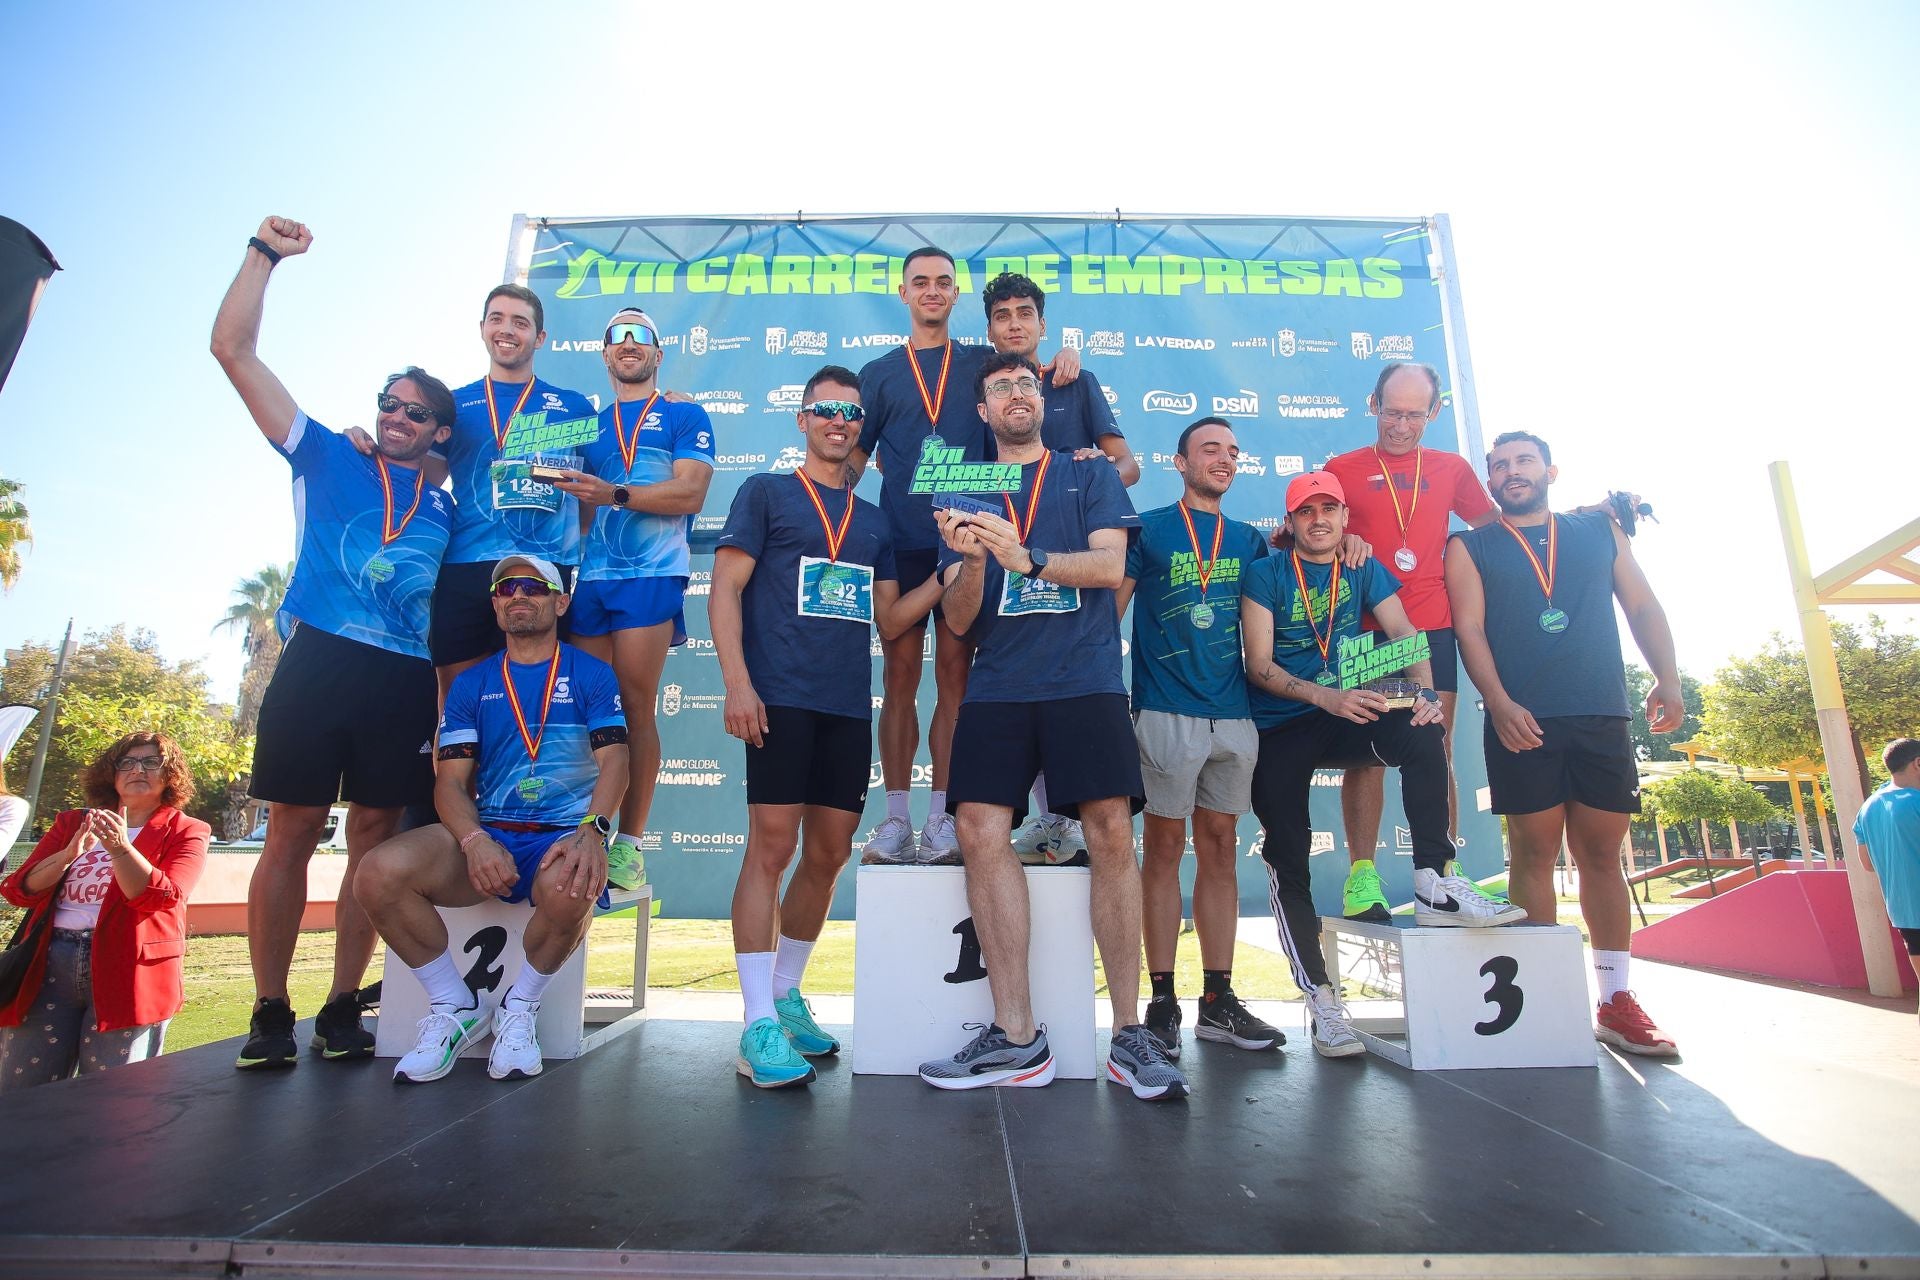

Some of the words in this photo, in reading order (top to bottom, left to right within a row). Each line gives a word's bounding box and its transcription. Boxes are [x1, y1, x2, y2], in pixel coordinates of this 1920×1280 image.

[598, 255, 678, 294] VII
[1071, 254, 1404, 299] EMPRESAS
[551, 340, 573, 352] LA
[842, 337, 862, 348] LA
[1135, 336, 1155, 347] LA
[1156, 336, 1216, 351] VERDAD
[1298, 338, 1338, 347] Ayuntamiento
[713, 391, 743, 401] GLOBAL
[1151, 397, 1190, 409] VIDAL
[1311, 395, 1342, 405] GLOBAL
[1213, 396, 1258, 413] DSM
[506, 414, 599, 446] CARRERA
[524, 431, 599, 456] EMPRESAS
[932, 448, 965, 464] VII
[915, 464, 1022, 481] CARRERA
[912, 481, 934, 493] DE
[935, 480, 1022, 493] EMPRESAS
[1341, 630, 1431, 679] CARRERA
[1342, 676, 1360, 691] DE
[1360, 646, 1432, 685] EMPRESAS
[665, 759, 687, 770] AMC
[688, 759, 721, 770] GLOBAL
[671, 831, 745, 844] Brocalsa
[944, 917, 988, 984] 1
[463, 925, 508, 994] 2
[1474, 955, 1524, 1036] 3
